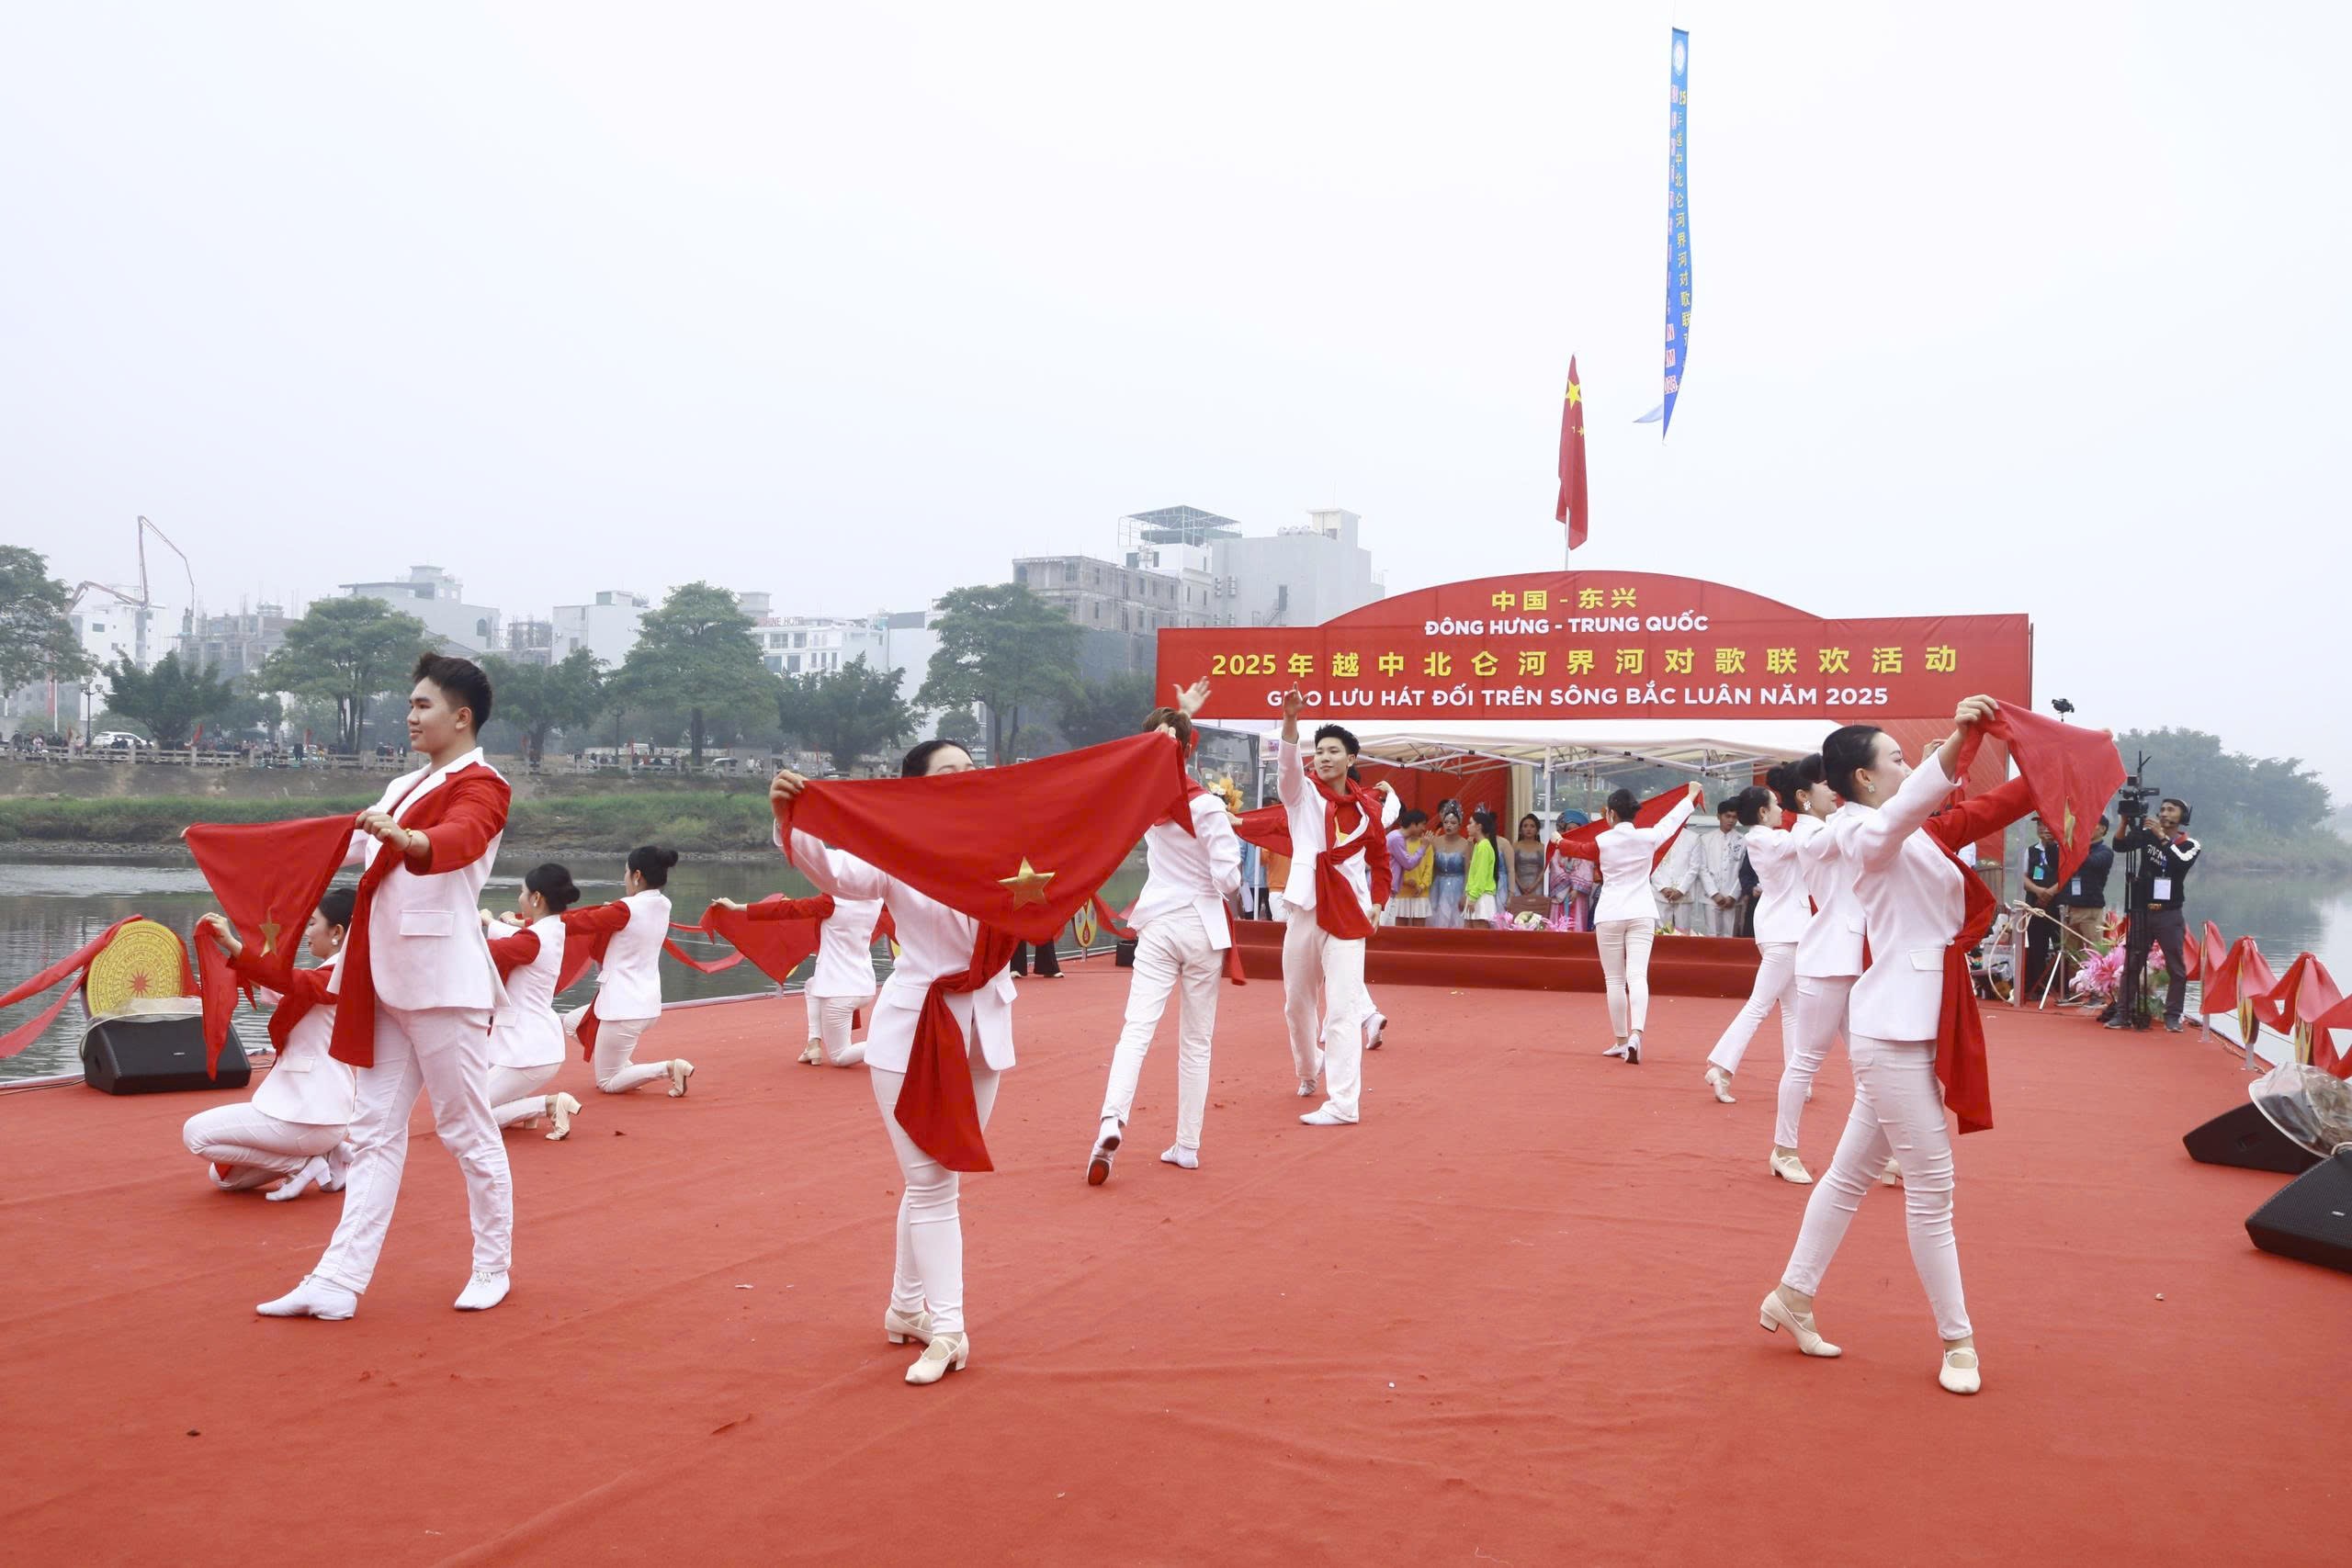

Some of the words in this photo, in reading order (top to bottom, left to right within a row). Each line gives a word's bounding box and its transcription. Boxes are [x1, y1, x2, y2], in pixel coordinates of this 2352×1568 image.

[1491, 590, 1548, 613] 中国
[1577, 587, 1637, 610] 东兴
[1424, 615, 1485, 636] ĐÔNG
[1489, 616, 1550, 635] HƯNG
[1567, 615, 1640, 633] TRUNG
[1645, 609, 1709, 632] QUỐC
[1266, 690, 1322, 706] GO
[1329, 687, 1374, 706] LƯU
[1381, 686, 1426, 706] HÁT
[1431, 683, 1474, 706] ĐỐI
[1480, 685, 1543, 706] TRÊN
[1550, 684, 1618, 705] SÔNG
[1625, 681, 1677, 705] BẮC
[1684, 683, 1752, 705] LUÂN
[1759, 683, 1817, 705] NĂM
[1825, 687, 1888, 705] 2025
